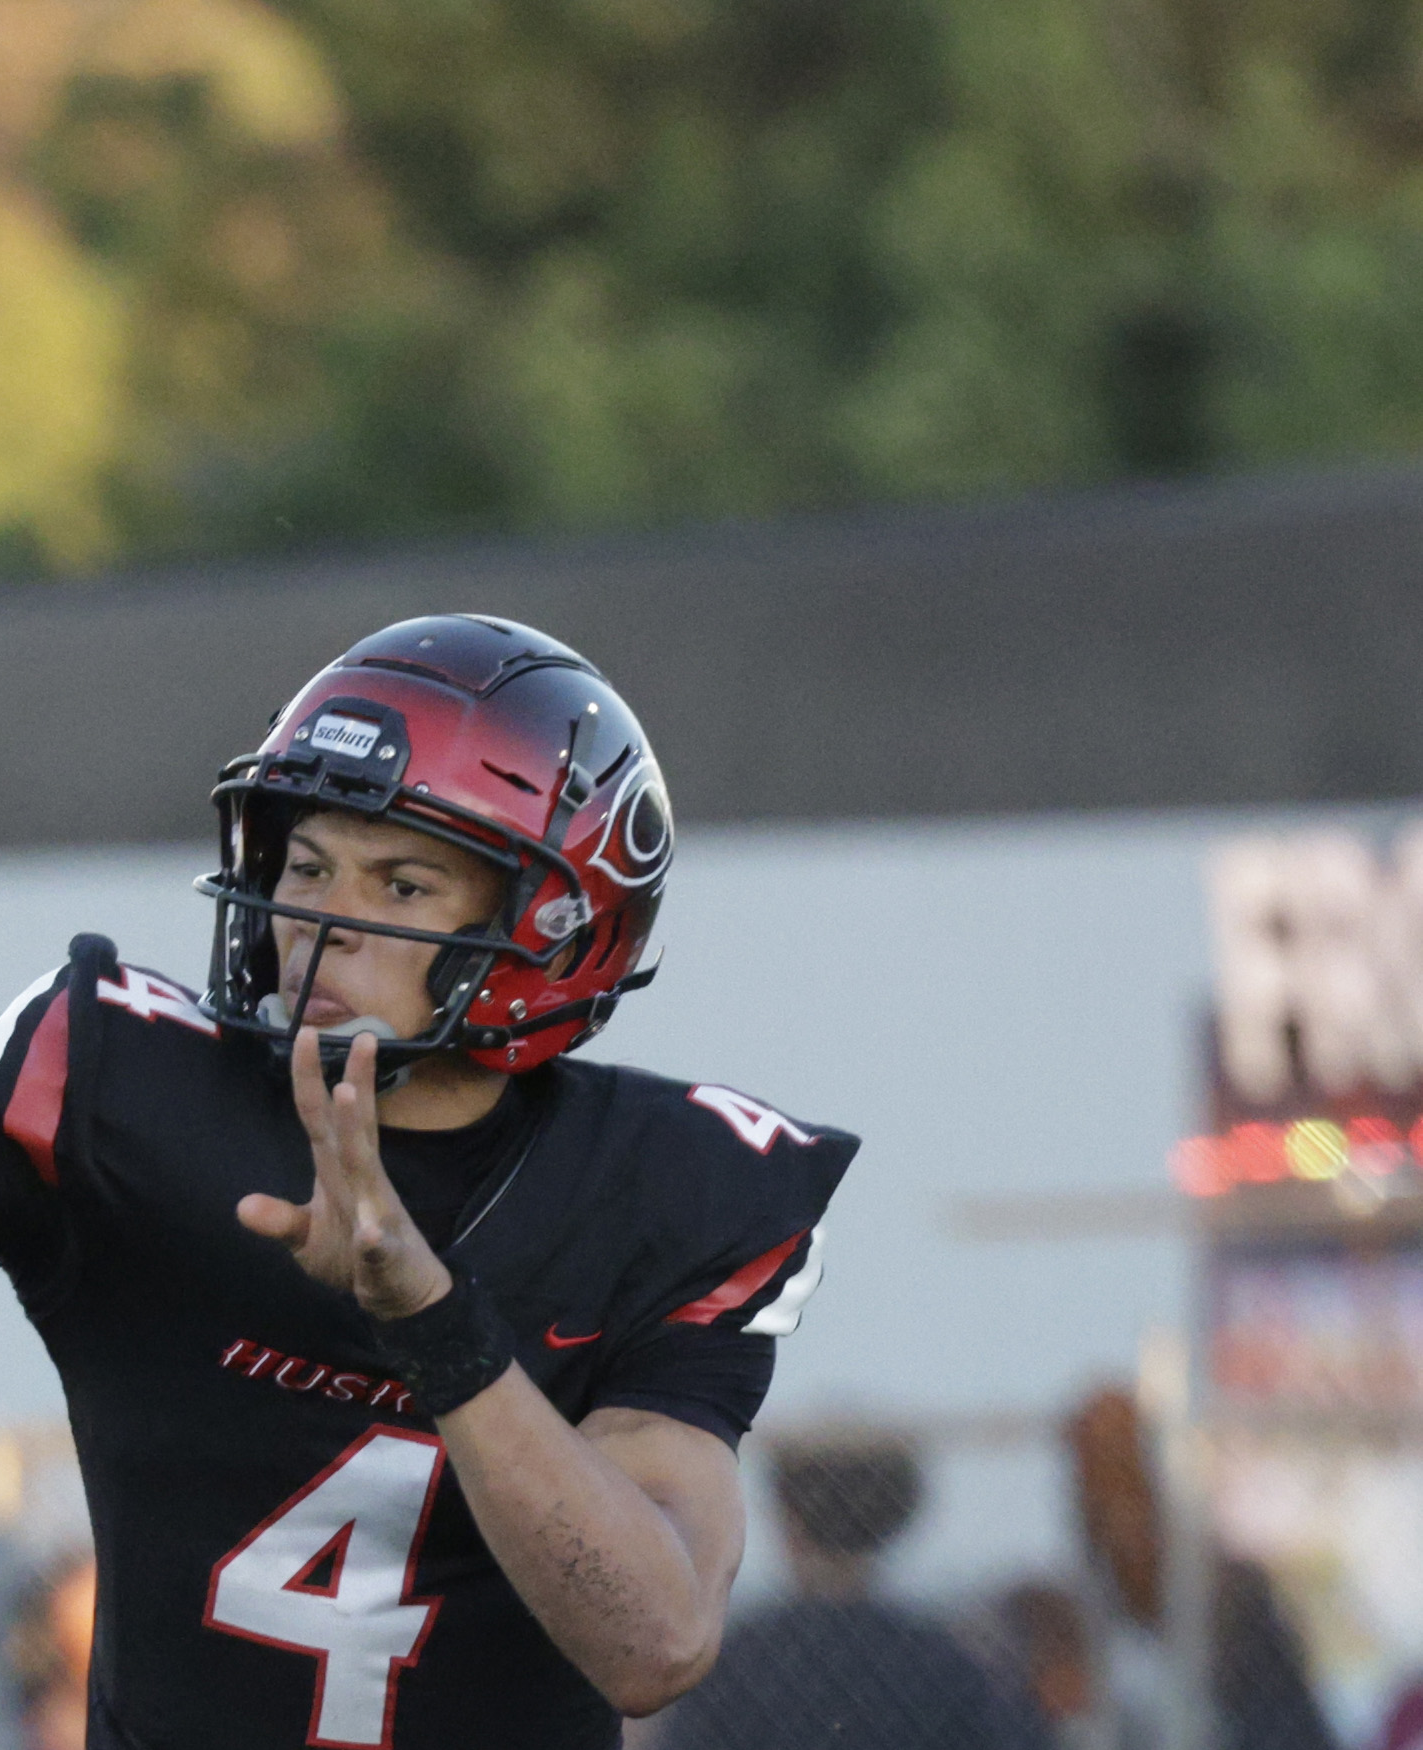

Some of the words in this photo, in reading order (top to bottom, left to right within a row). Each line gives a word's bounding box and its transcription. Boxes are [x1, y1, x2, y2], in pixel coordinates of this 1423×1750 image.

[314, 724, 375, 750] schutt
[95, 964, 223, 1040] 4
[686, 1082, 825, 1156] 4
